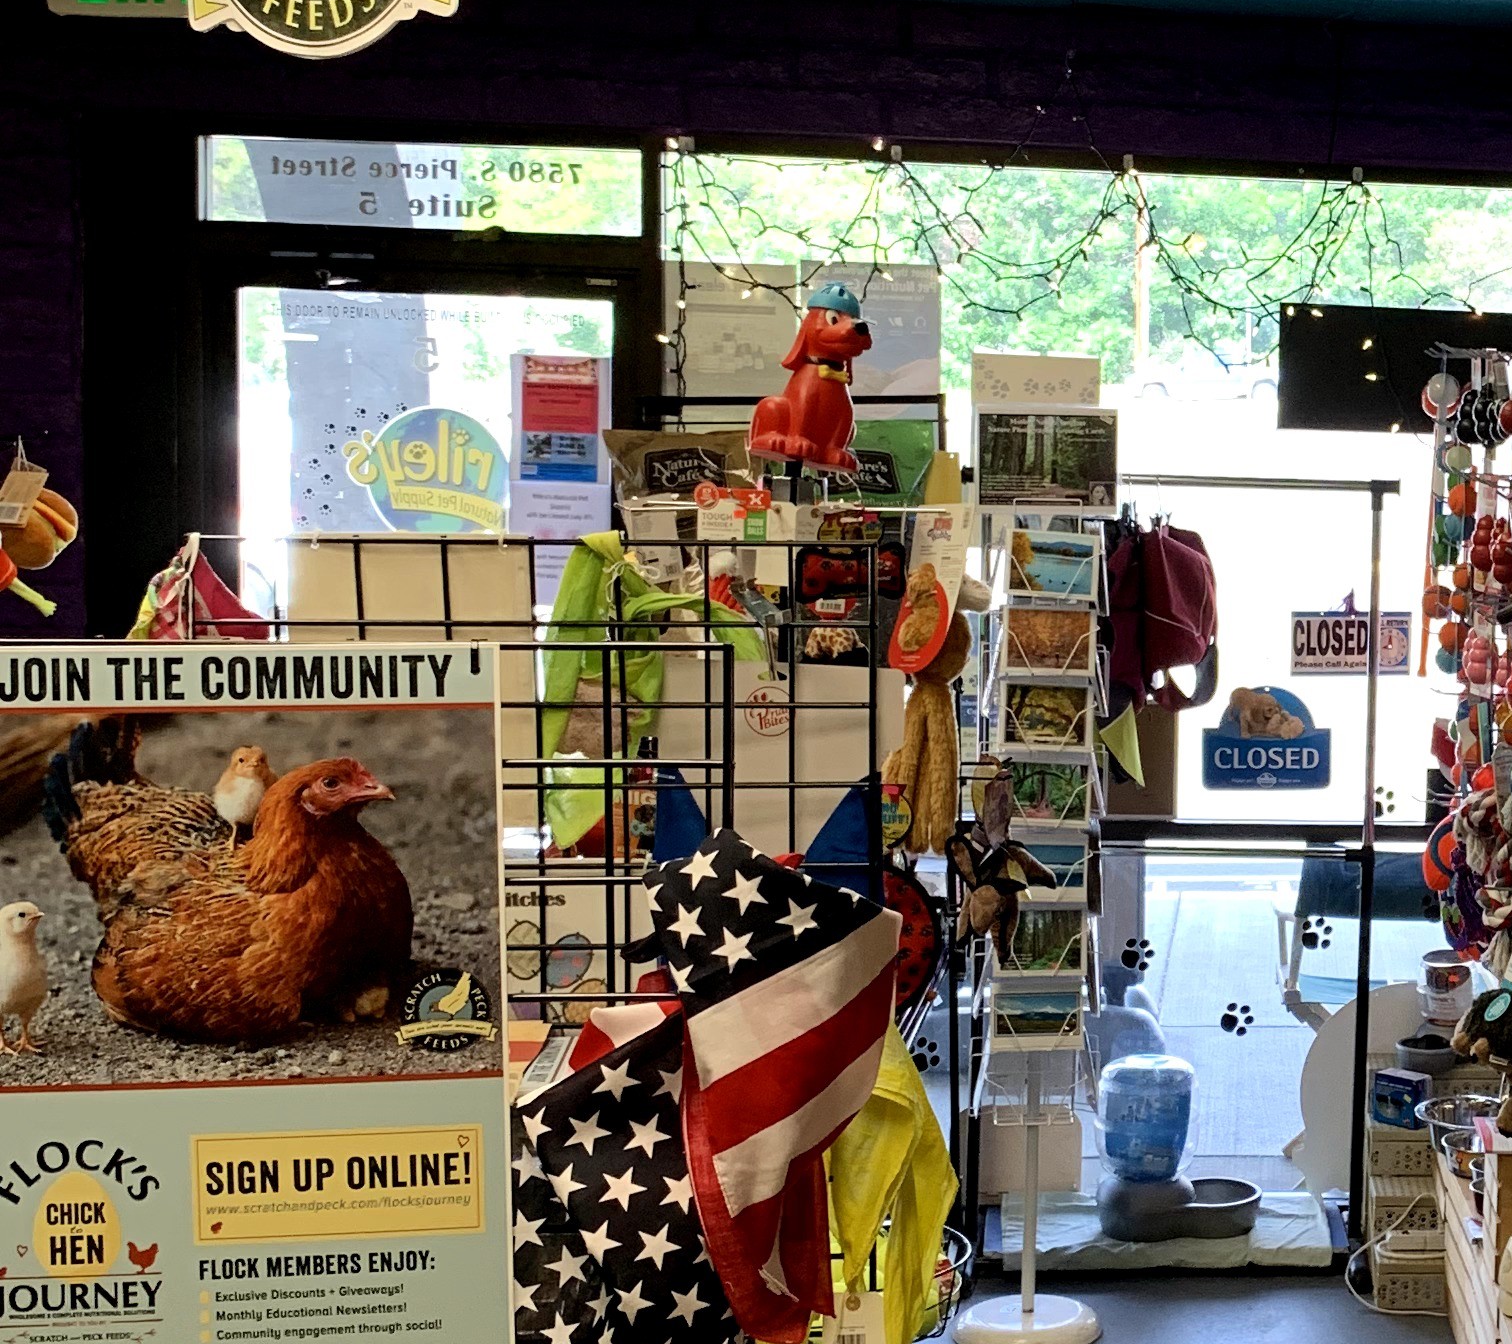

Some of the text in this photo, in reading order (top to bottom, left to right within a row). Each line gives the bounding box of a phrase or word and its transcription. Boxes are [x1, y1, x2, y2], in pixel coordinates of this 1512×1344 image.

[294, 304, 323, 318] DOOR
[327, 305, 340, 318] TO
[342, 305, 380, 320] REMAIN
[383, 306, 437, 322] UNLOCKED
[440, 309, 471, 324] WHILE
[702, 511, 733, 522] TOUGH
[1293, 619, 1369, 657] CLOSED
[1294, 661, 1323, 669] Please
[1325, 660, 1342, 668] Call
[0, 653, 453, 703] JOIN THE COMMUNITY
[1213, 746, 1320, 770] CLOSED
[404, 973, 487, 1021] SCRATCH PECK
[423, 1036, 469, 1049] FEEDS
[0, 1139, 160, 1205] FLOCK'S
[205, 1151, 472, 1196] SIGN UP ONLINE!
[46, 1202, 106, 1226] CHICK
[205, 1193, 472, 1216] www.scratchandpeck.com/flocksjourney
[50, 1234, 104, 1266] HEN
[200, 1249, 436, 1280] FLOCK MEMBERS ENJOY:
[0, 1280, 163, 1320] JOURNEY
[215, 1289, 267, 1303] Exclusive
[271, 1286, 326, 1300] Discounts
[338, 1283, 405, 1299] Giveaways!
[215, 1302, 407, 1322] Monthly Educational Newsletters!
[216, 1318, 443, 1341] Community engagement through social!
